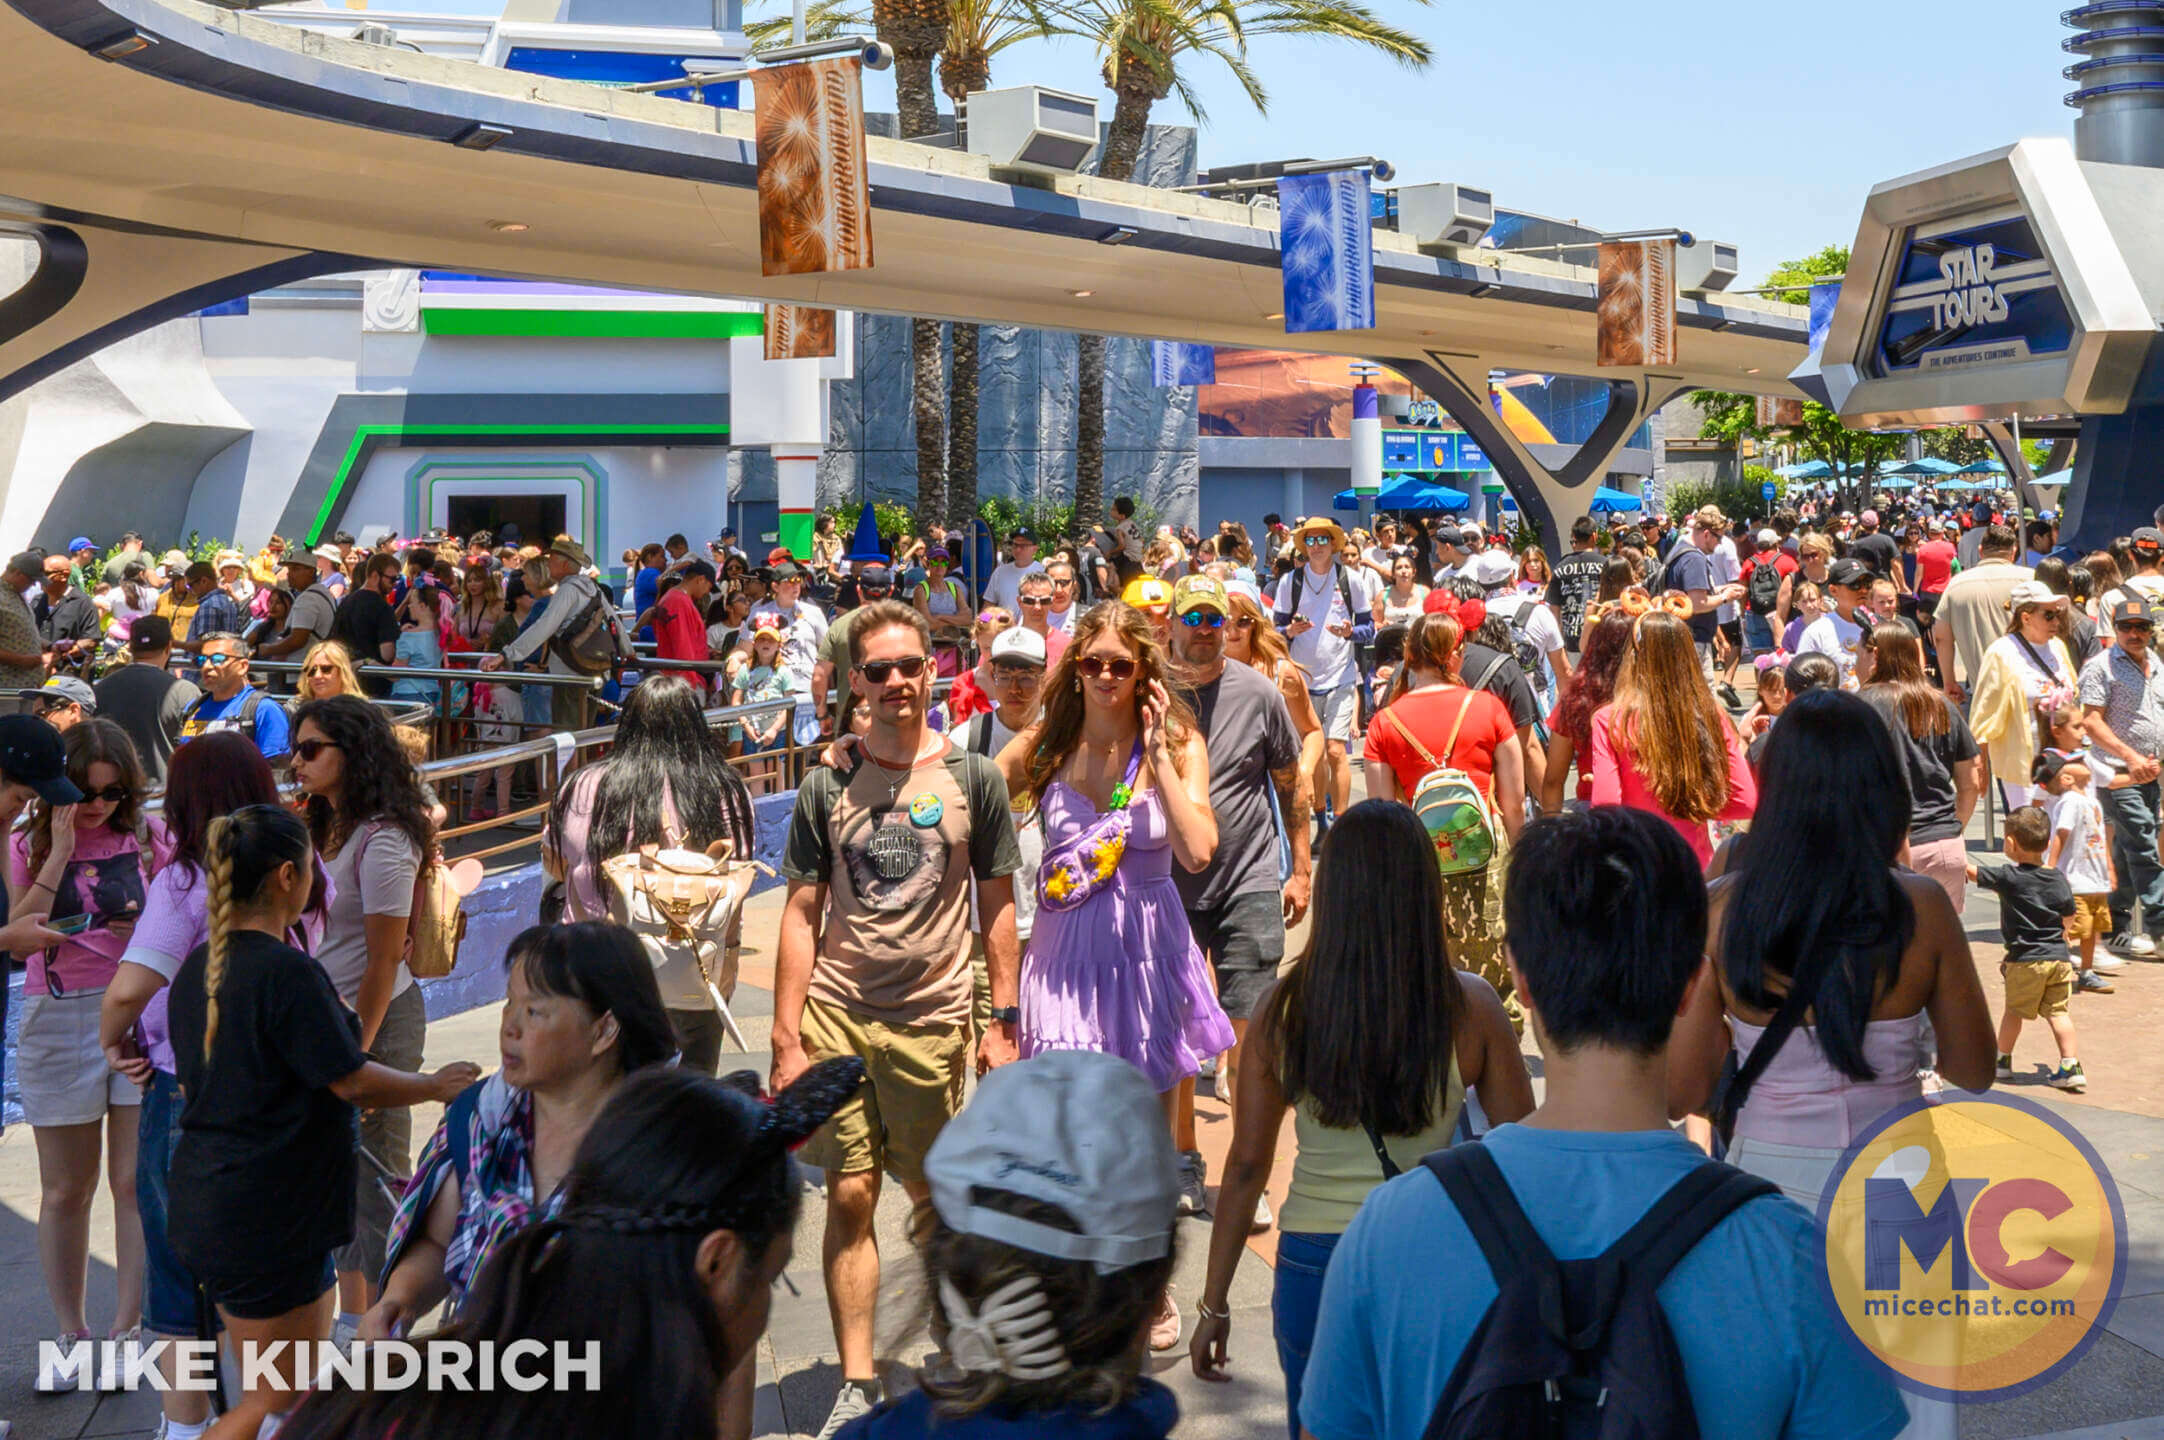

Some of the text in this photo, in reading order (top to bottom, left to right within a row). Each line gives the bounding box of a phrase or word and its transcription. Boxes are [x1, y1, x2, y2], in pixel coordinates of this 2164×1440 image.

[1939, 243, 1995, 289] STAR
[1933, 285, 2008, 331] TOURS
[1943, 351, 1983, 366] ADVENTURES
[1984, 347, 2017, 361] CONTINUE
[869, 836, 918, 854] ACTUALLY
